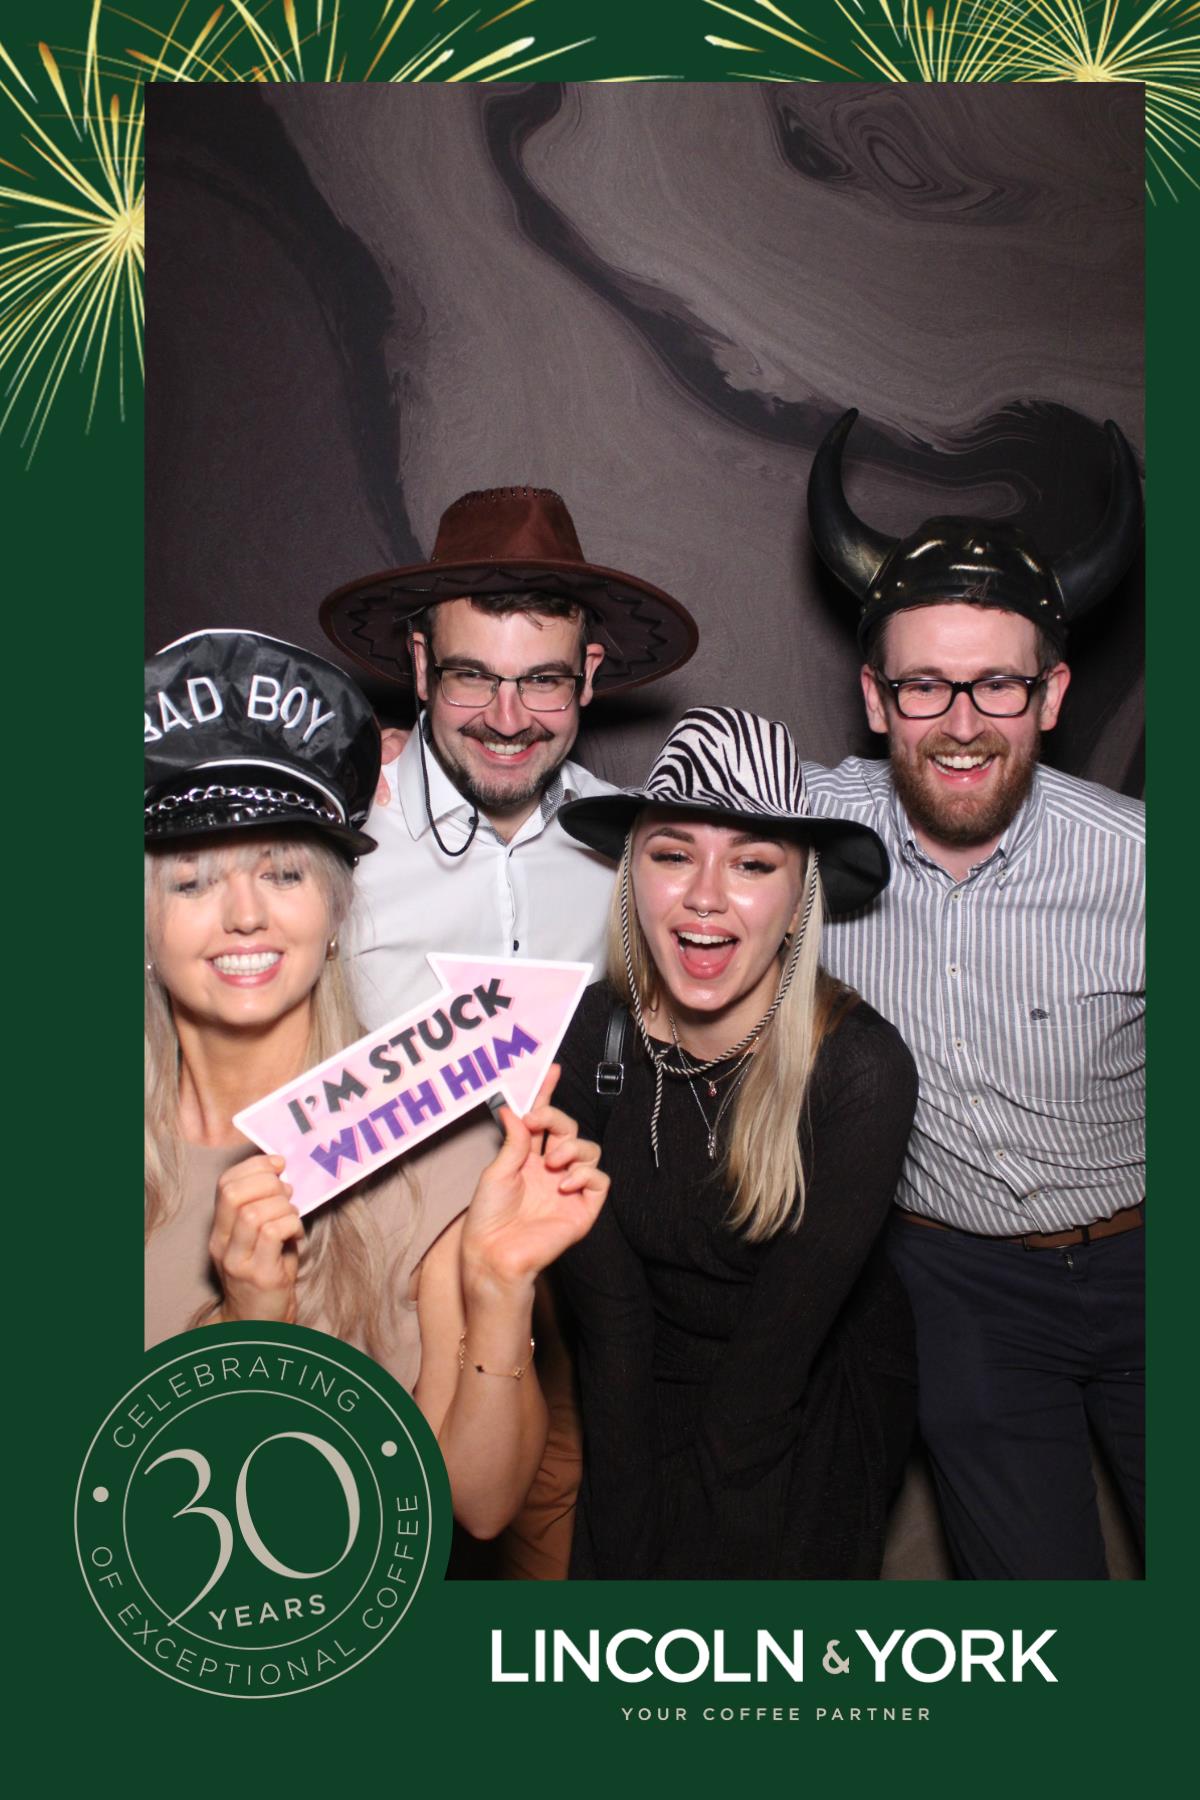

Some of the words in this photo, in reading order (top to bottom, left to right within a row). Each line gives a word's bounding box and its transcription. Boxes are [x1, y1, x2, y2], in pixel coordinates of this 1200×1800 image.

[247, 674, 336, 743] BOY
[368, 978, 514, 1084] STUCK
[310, 1079, 445, 1179] WITH
[440, 1023, 541, 1101] HIM
